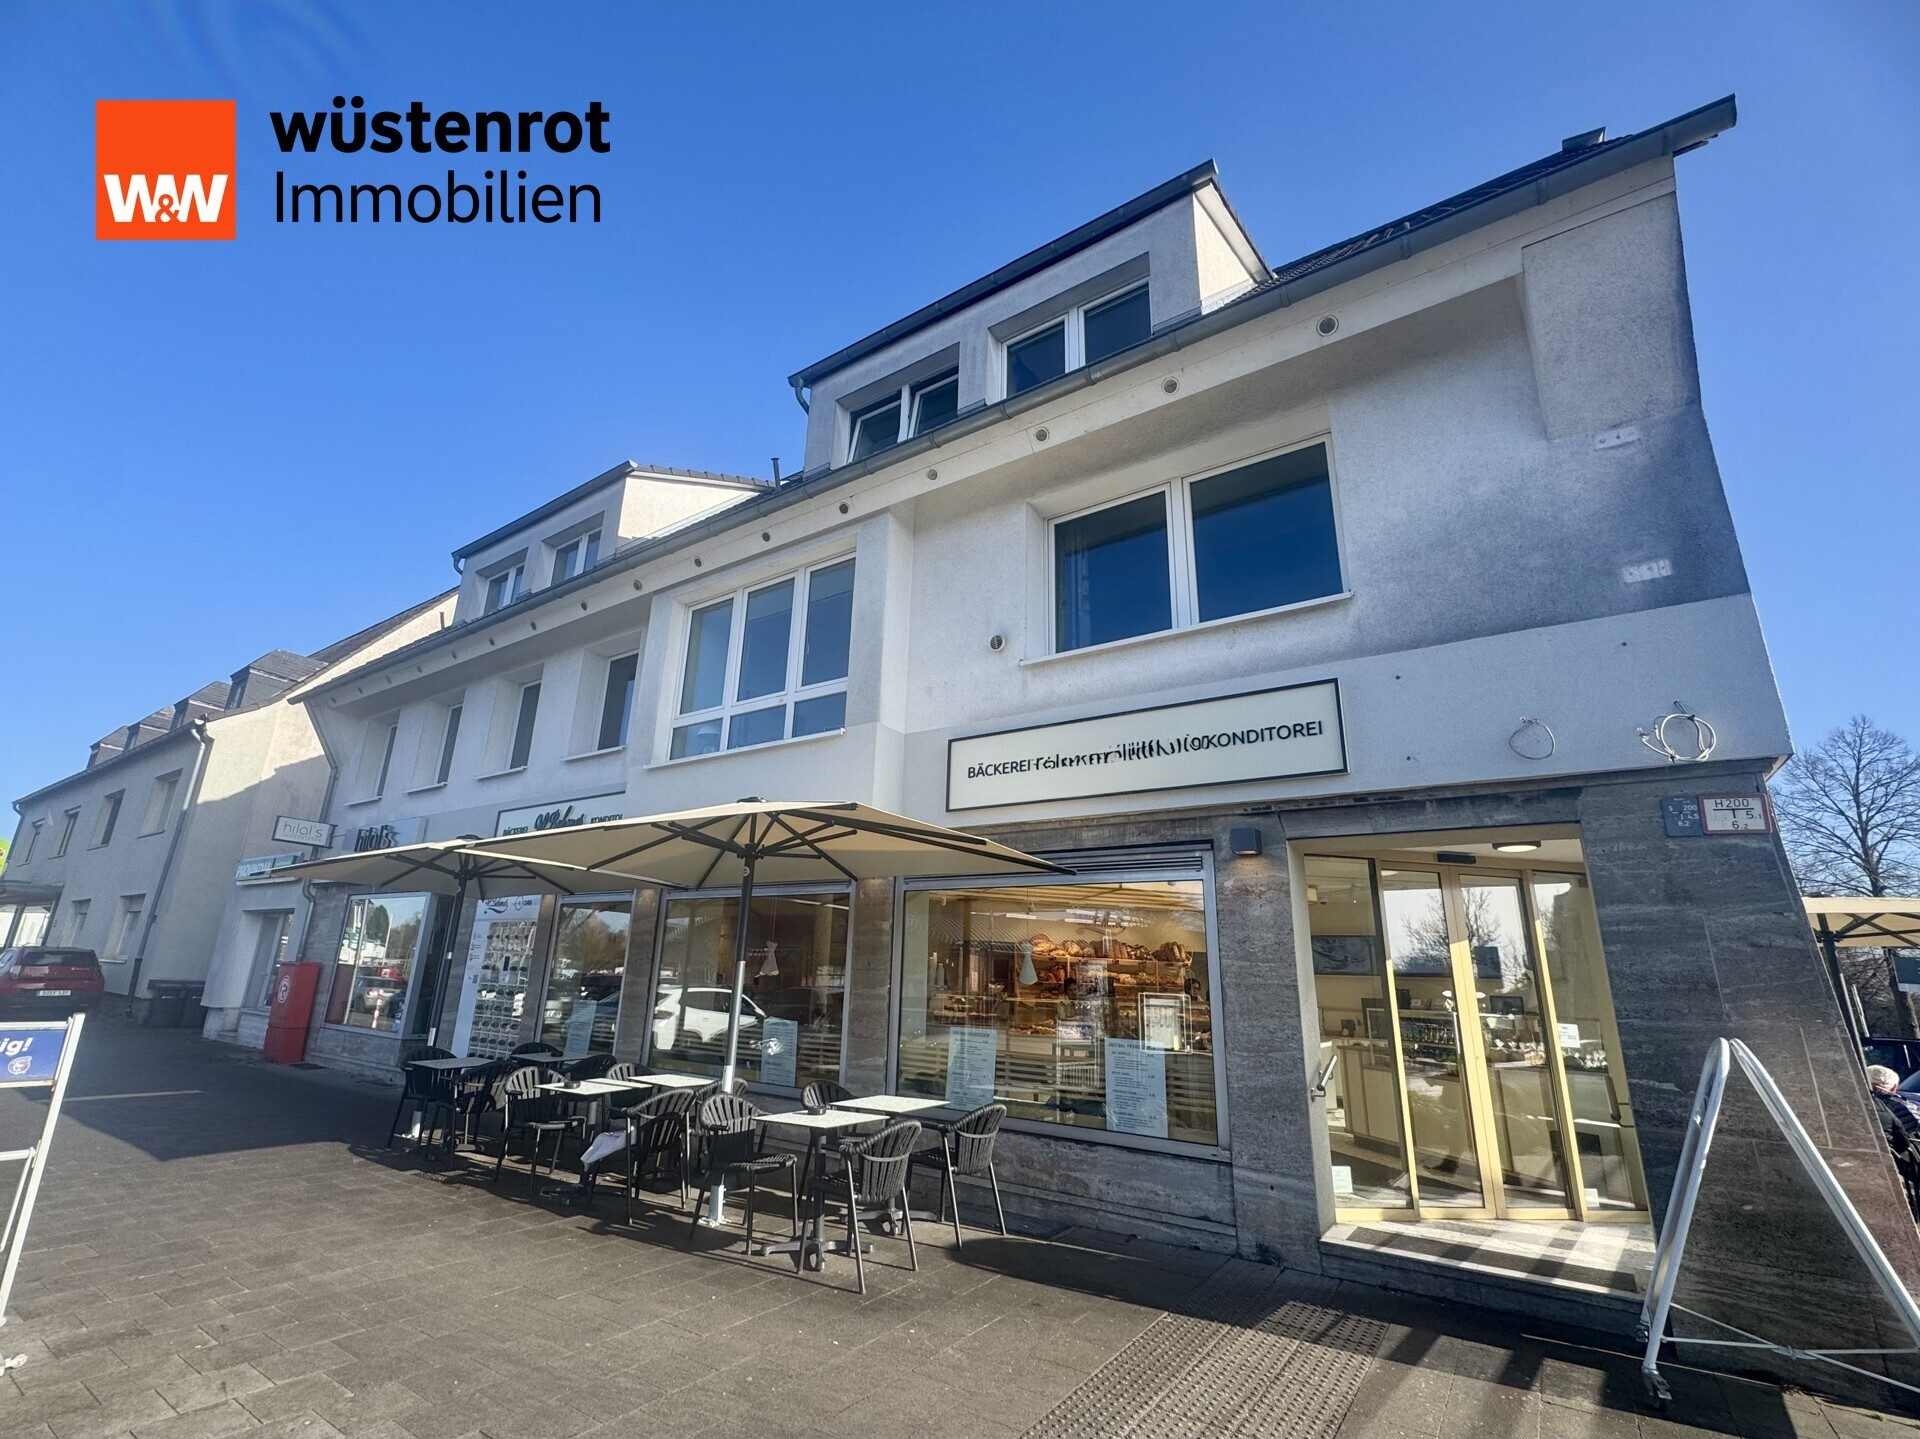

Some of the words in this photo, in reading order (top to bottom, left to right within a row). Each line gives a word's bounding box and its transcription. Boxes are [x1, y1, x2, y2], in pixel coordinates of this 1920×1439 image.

[967, 758, 1031, 779] BÄCKEREI
[1208, 719, 1323, 750] KONDITOREI
[1714, 798, 1750, 808] H200
